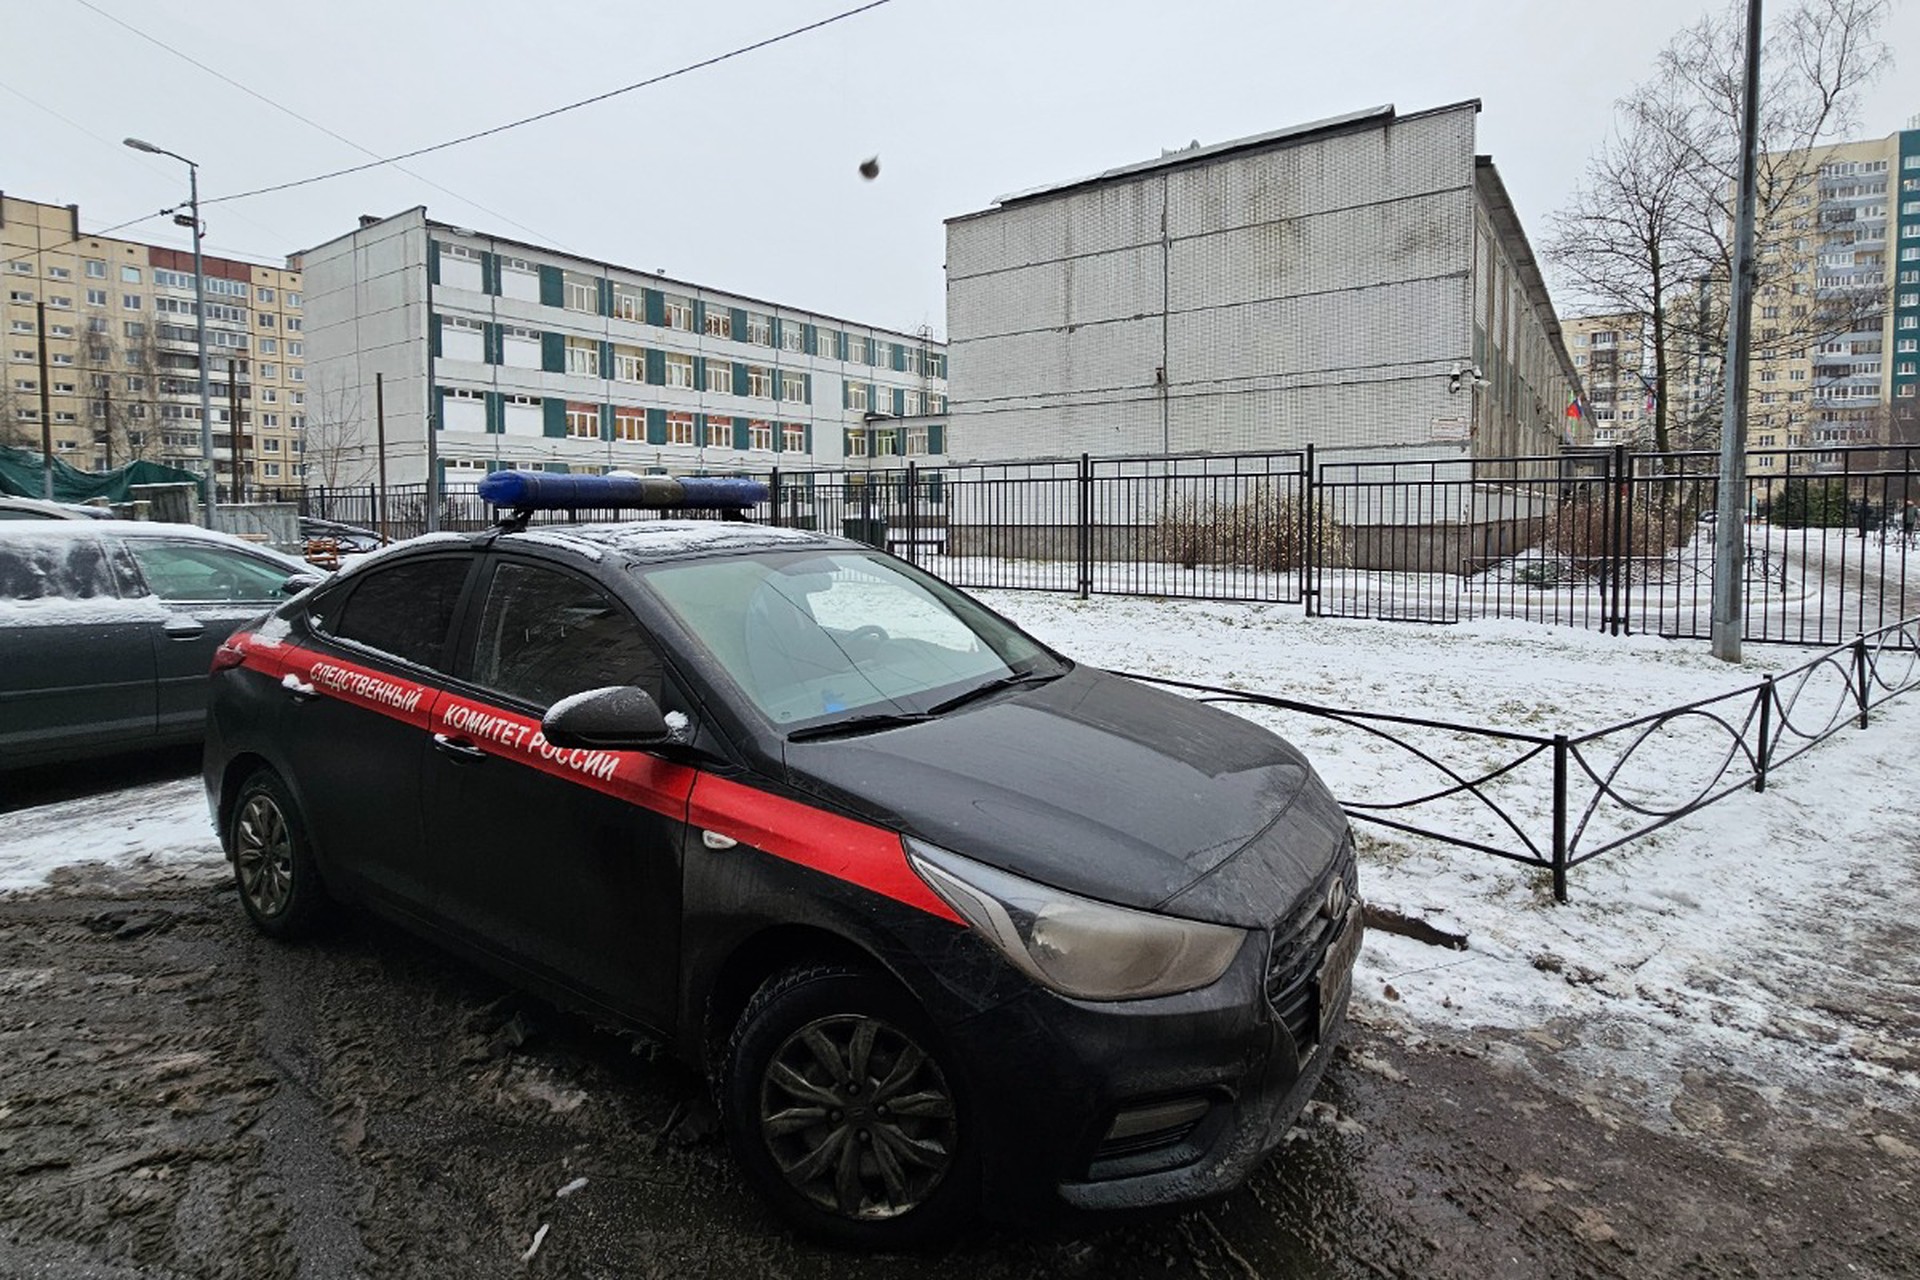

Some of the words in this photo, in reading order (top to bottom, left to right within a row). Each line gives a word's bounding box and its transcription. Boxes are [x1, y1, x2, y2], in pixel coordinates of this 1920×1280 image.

[310, 662, 423, 712] СЛЕДСТВЕННЫЙ
[443, 704, 531, 748] КОМИТЕТ
[528, 732, 620, 781] РОССИИ
